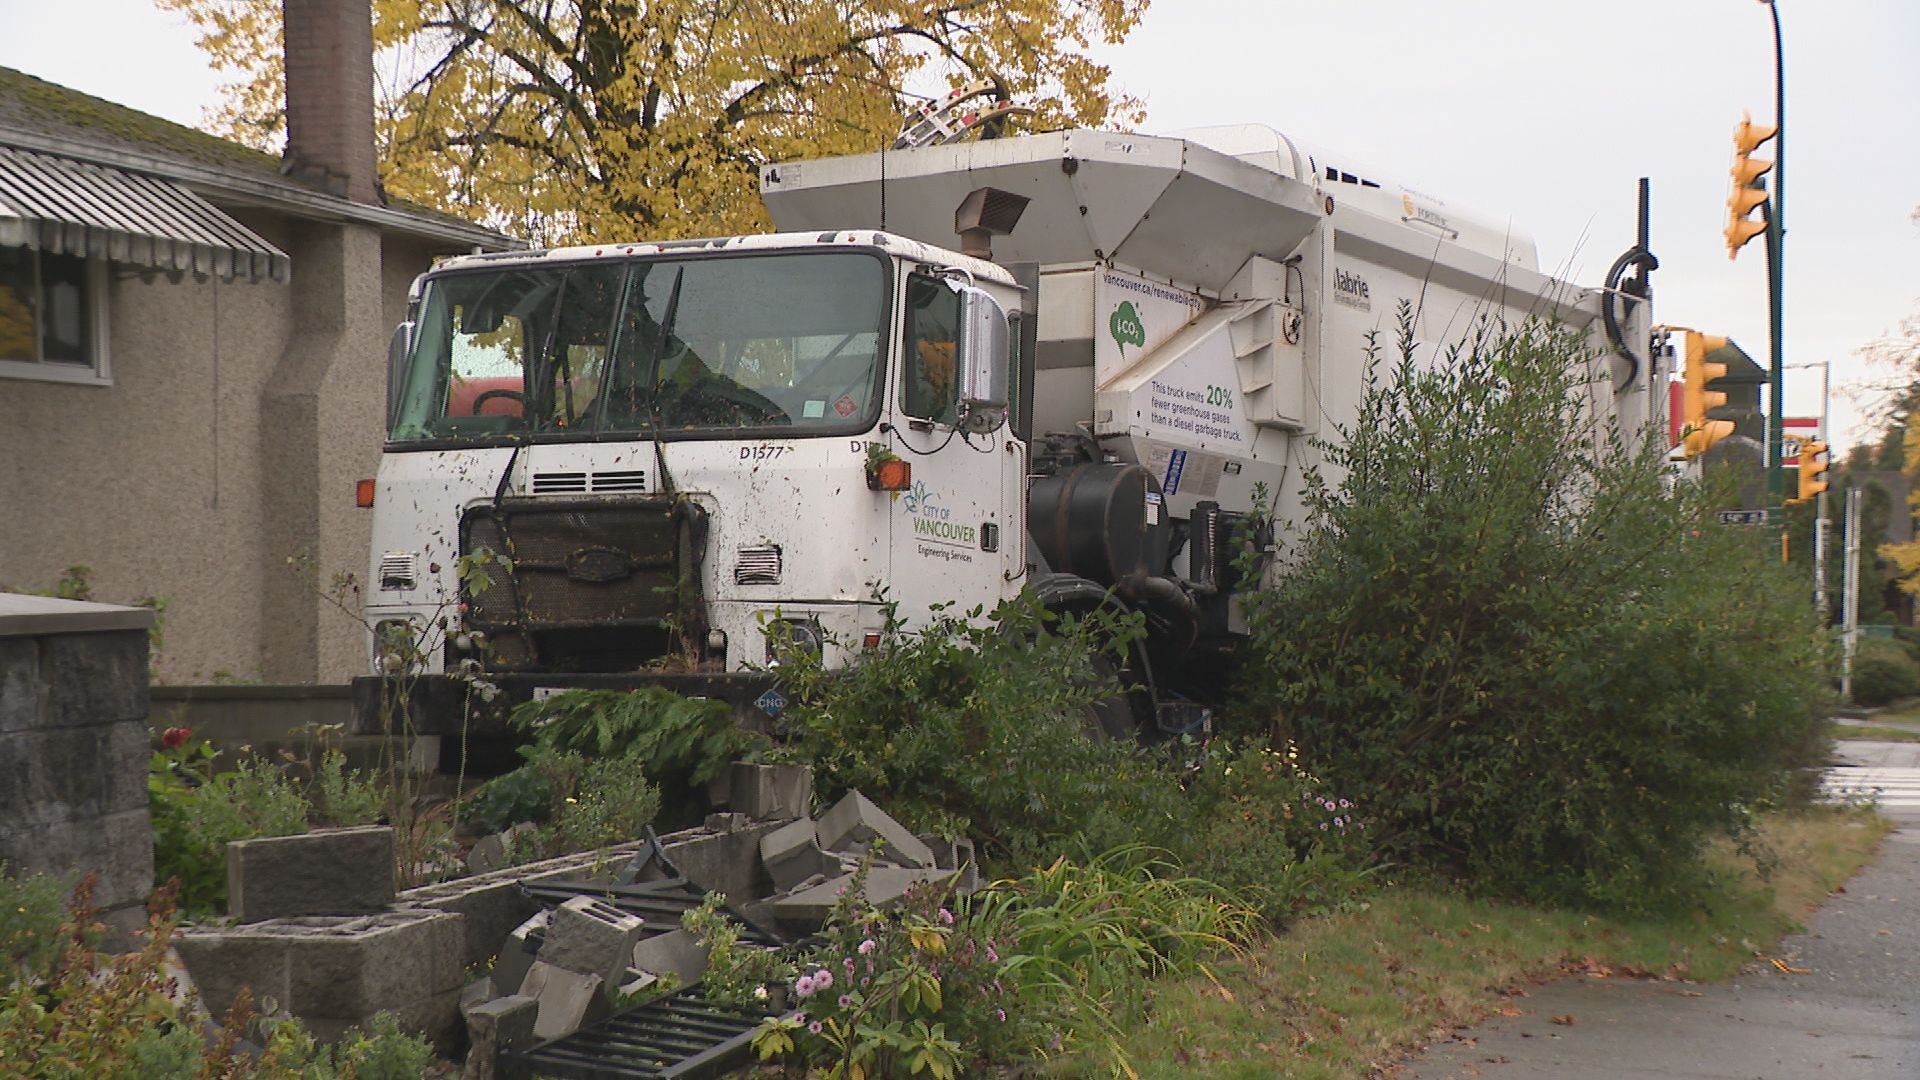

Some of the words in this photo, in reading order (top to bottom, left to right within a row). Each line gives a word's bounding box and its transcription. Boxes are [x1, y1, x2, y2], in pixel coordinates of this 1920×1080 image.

[1152, 381, 1166, 394] This
[1167, 385, 1185, 399] truck
[1186, 390, 1204, 403] emits
[1206, 385, 1233, 410] 20%
[1152, 396, 1171, 410] fewer
[1172, 402, 1210, 420] greenhouse
[1212, 412, 1230, 424] gases
[1152, 412, 1167, 425] than
[1168, 417, 1173, 427] a
[1174, 417, 1194, 432] diesel
[1195, 423, 1222, 439] garbage
[740, 446, 784, 459] D1577
[923, 504, 939, 518] CITY
[940, 508, 950, 519] OF
[913, 517, 976, 543] VANCOUVER
[918, 544, 950, 561] Engineering
[950, 549, 973, 562] Services
[759, 698, 783, 708] CNG
